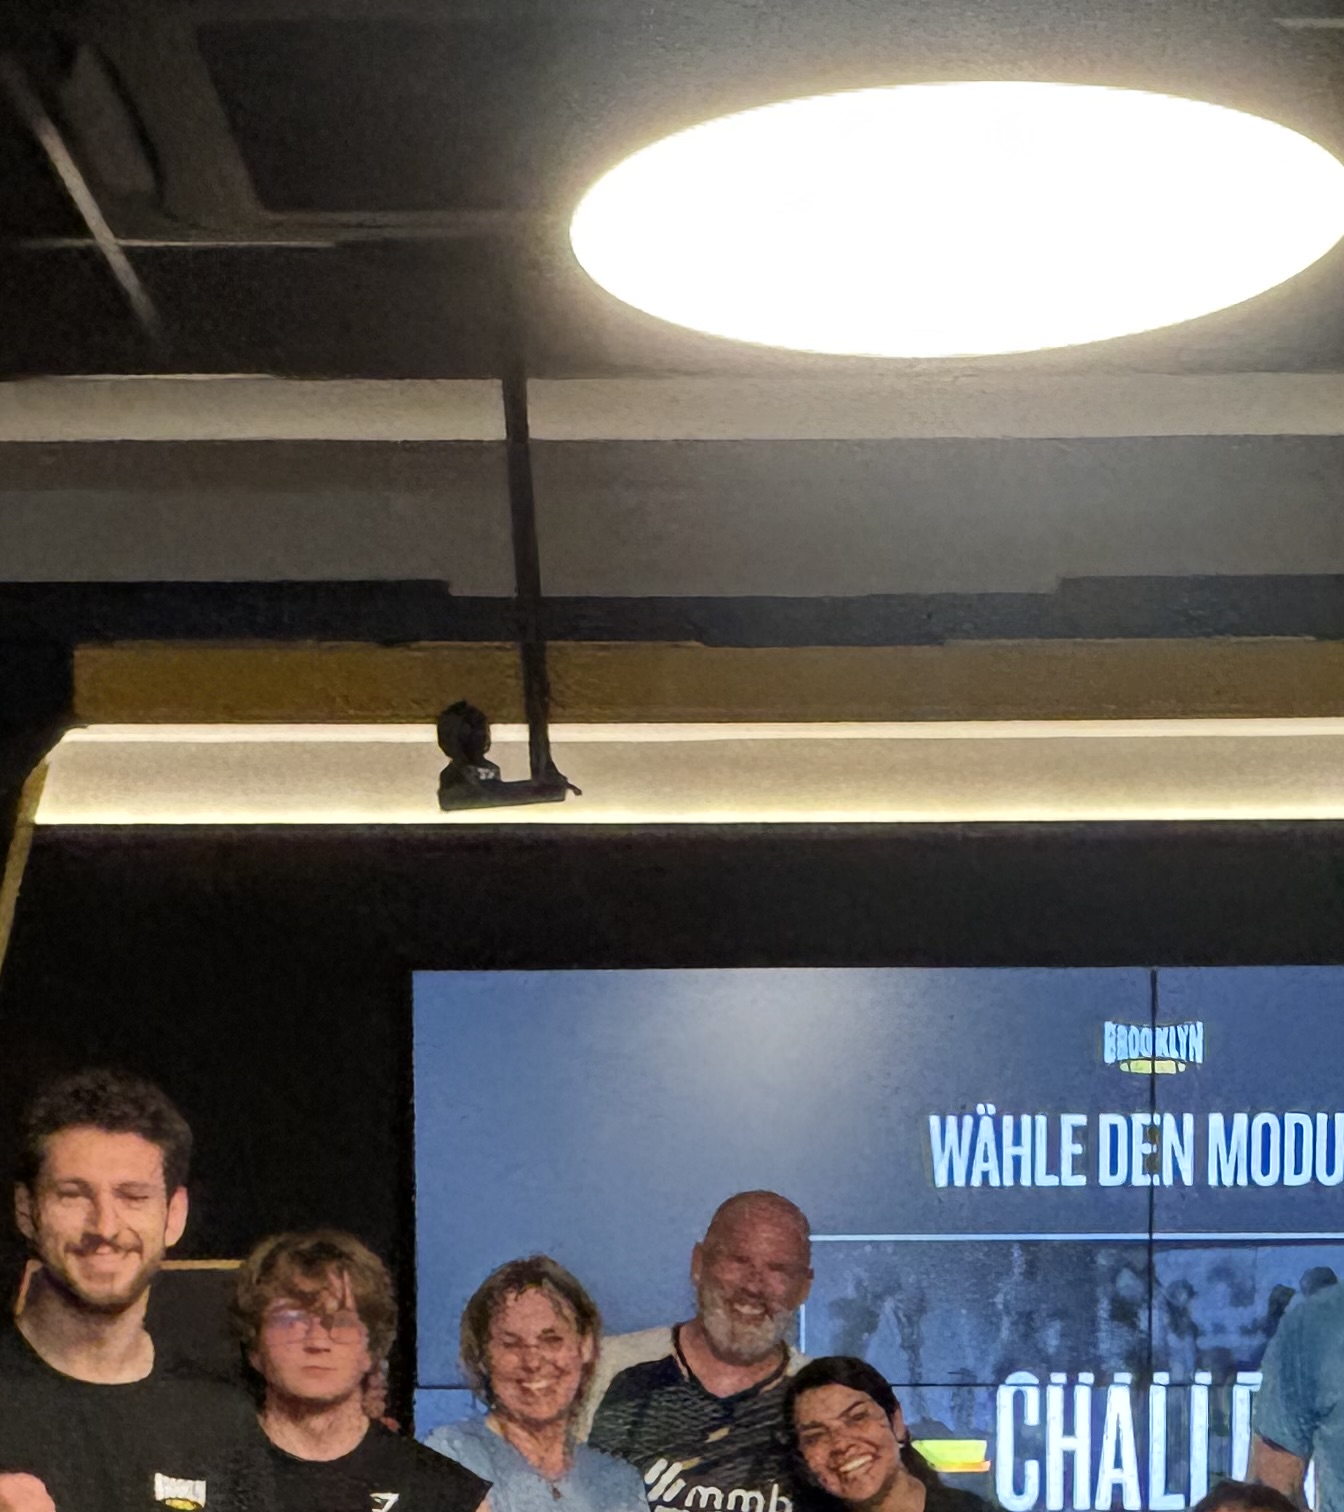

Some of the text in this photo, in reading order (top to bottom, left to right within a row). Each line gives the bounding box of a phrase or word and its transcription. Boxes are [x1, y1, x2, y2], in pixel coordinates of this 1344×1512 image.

[1104, 1020, 1204, 1064] BROOKLYN
[928, 1102, 1088, 1188] WÄHLE
[1098, 1110, 1195, 1188] DEN
